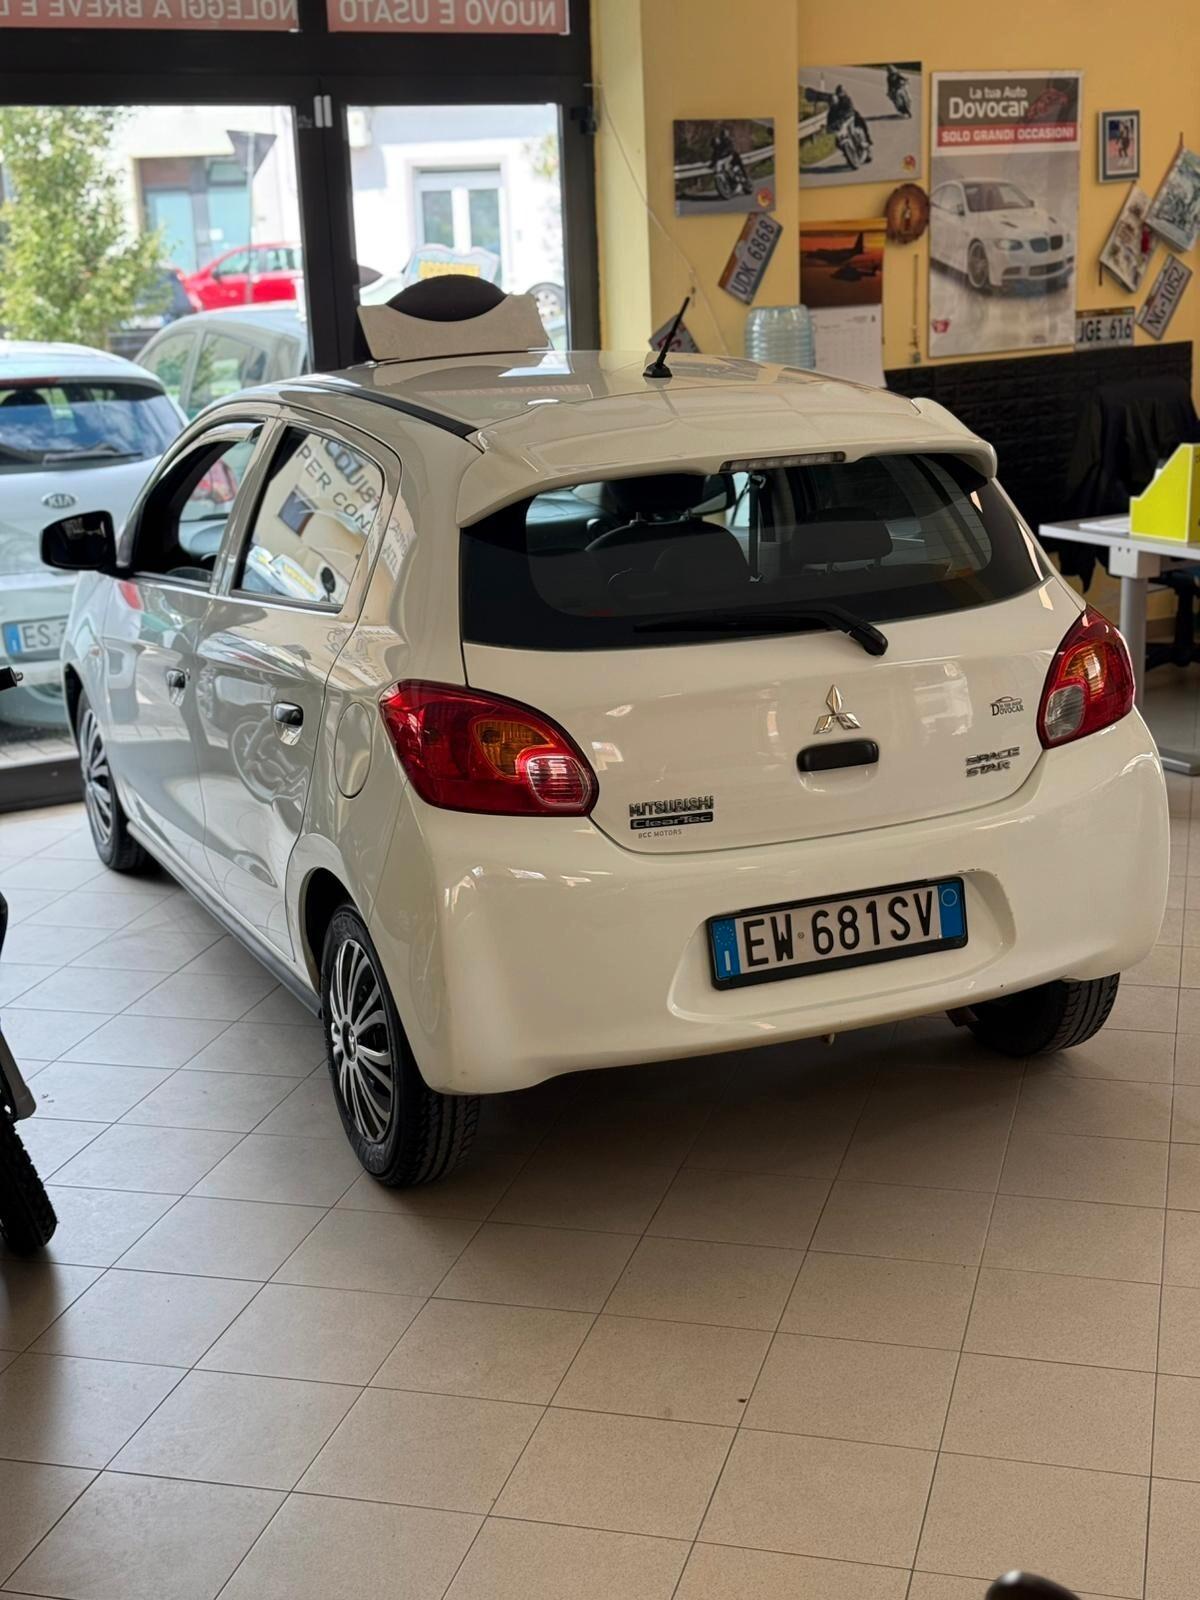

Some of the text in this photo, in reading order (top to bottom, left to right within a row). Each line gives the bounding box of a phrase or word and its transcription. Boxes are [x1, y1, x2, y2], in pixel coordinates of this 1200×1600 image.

[969, 86, 1028, 99] La tua Auto
[949, 97, 1030, 119] Dovocar
[942, 127, 1075, 142] SOLO GRANDI OCCASIONI
[731, 219, 776, 295] UDK 6868
[1110, 318, 1132, 340] 616
[296, 444, 332, 491] PER
[47, 493, 74, 508] KIA
[966, 746, 1020, 766] SPACE
[966, 760, 1010, 777] STAR
[629, 795, 714, 817] MITSUBISHI
[632, 813, 712, 829] ClearTec
[742, 913, 794, 966] EW
[811, 890, 933, 955] 681SV
